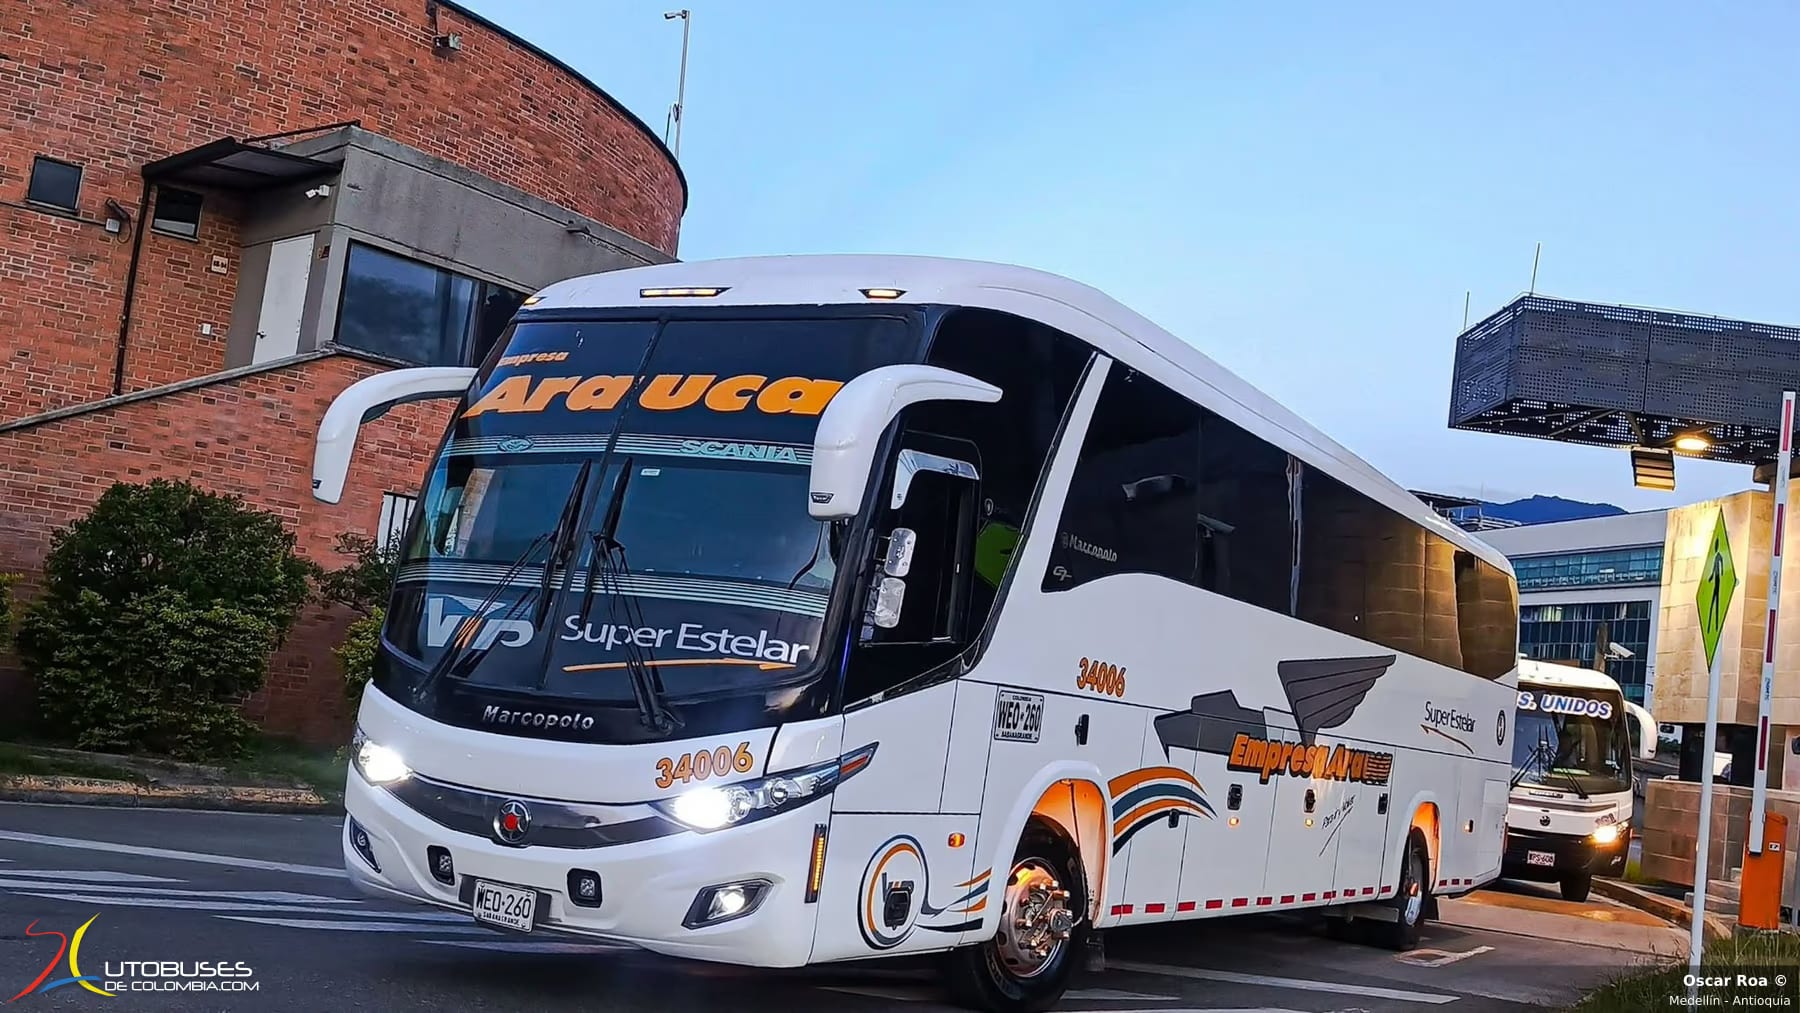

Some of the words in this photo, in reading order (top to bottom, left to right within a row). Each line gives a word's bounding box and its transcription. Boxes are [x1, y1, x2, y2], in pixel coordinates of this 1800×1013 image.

[459, 374, 845, 418] Arauca
[680, 440, 799, 462] SCANIA
[1069, 533, 1118, 562] Marcopolo
[561, 614, 672, 650] Super
[676, 622, 809, 664] Estelar
[1077, 657, 1127, 697] 34006
[482, 705, 594, 729] Marcopolo
[1540, 694, 1612, 719] UNIDOS
[655, 742, 754, 789] 34006
[1227, 732, 1330, 784] Empresa
